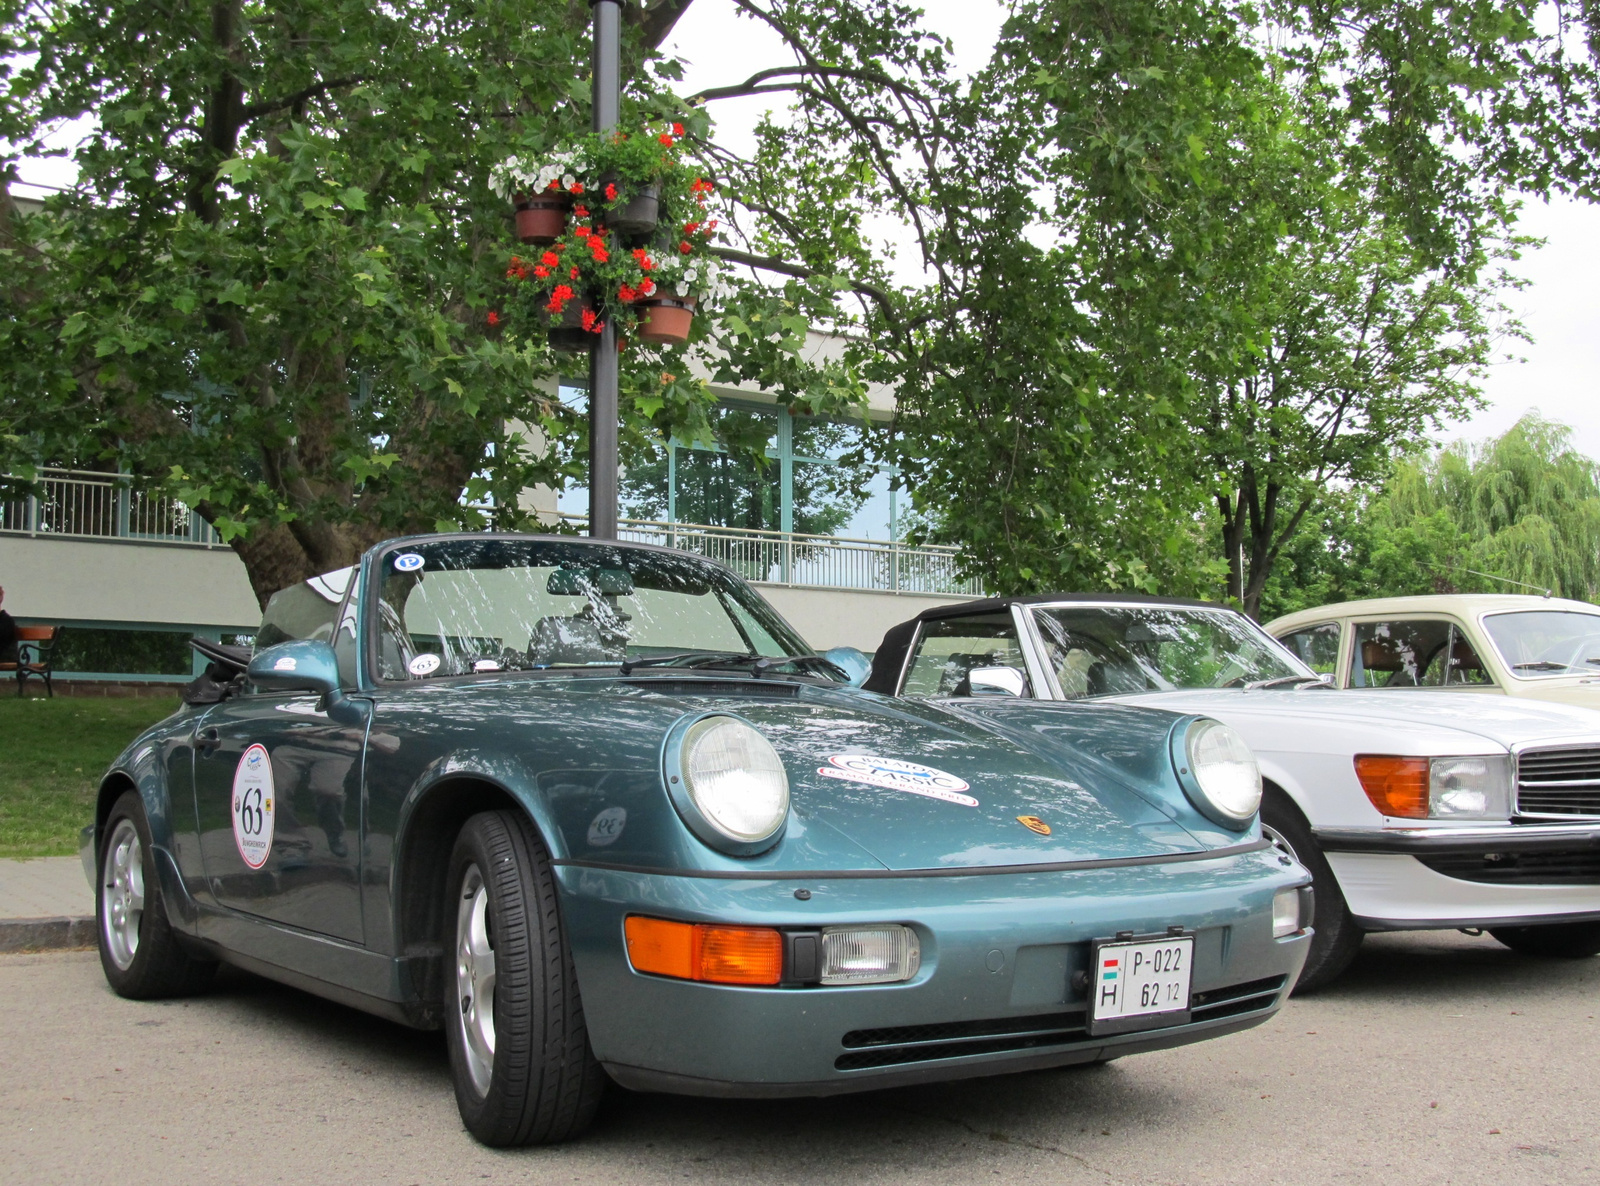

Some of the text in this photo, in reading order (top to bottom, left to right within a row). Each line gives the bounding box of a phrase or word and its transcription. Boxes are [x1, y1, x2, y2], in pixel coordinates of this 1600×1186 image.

[416, 660, 432, 670] 63
[862, 757, 940, 776] BALATON
[828, 770, 968, 803] RAMADA GRAND PRIX
[242, 787, 263, 836] 63
[1133, 947, 1182, 976] P-022
[1101, 984, 1117, 1007] H
[1141, 982, 1180, 1007] 62 12
